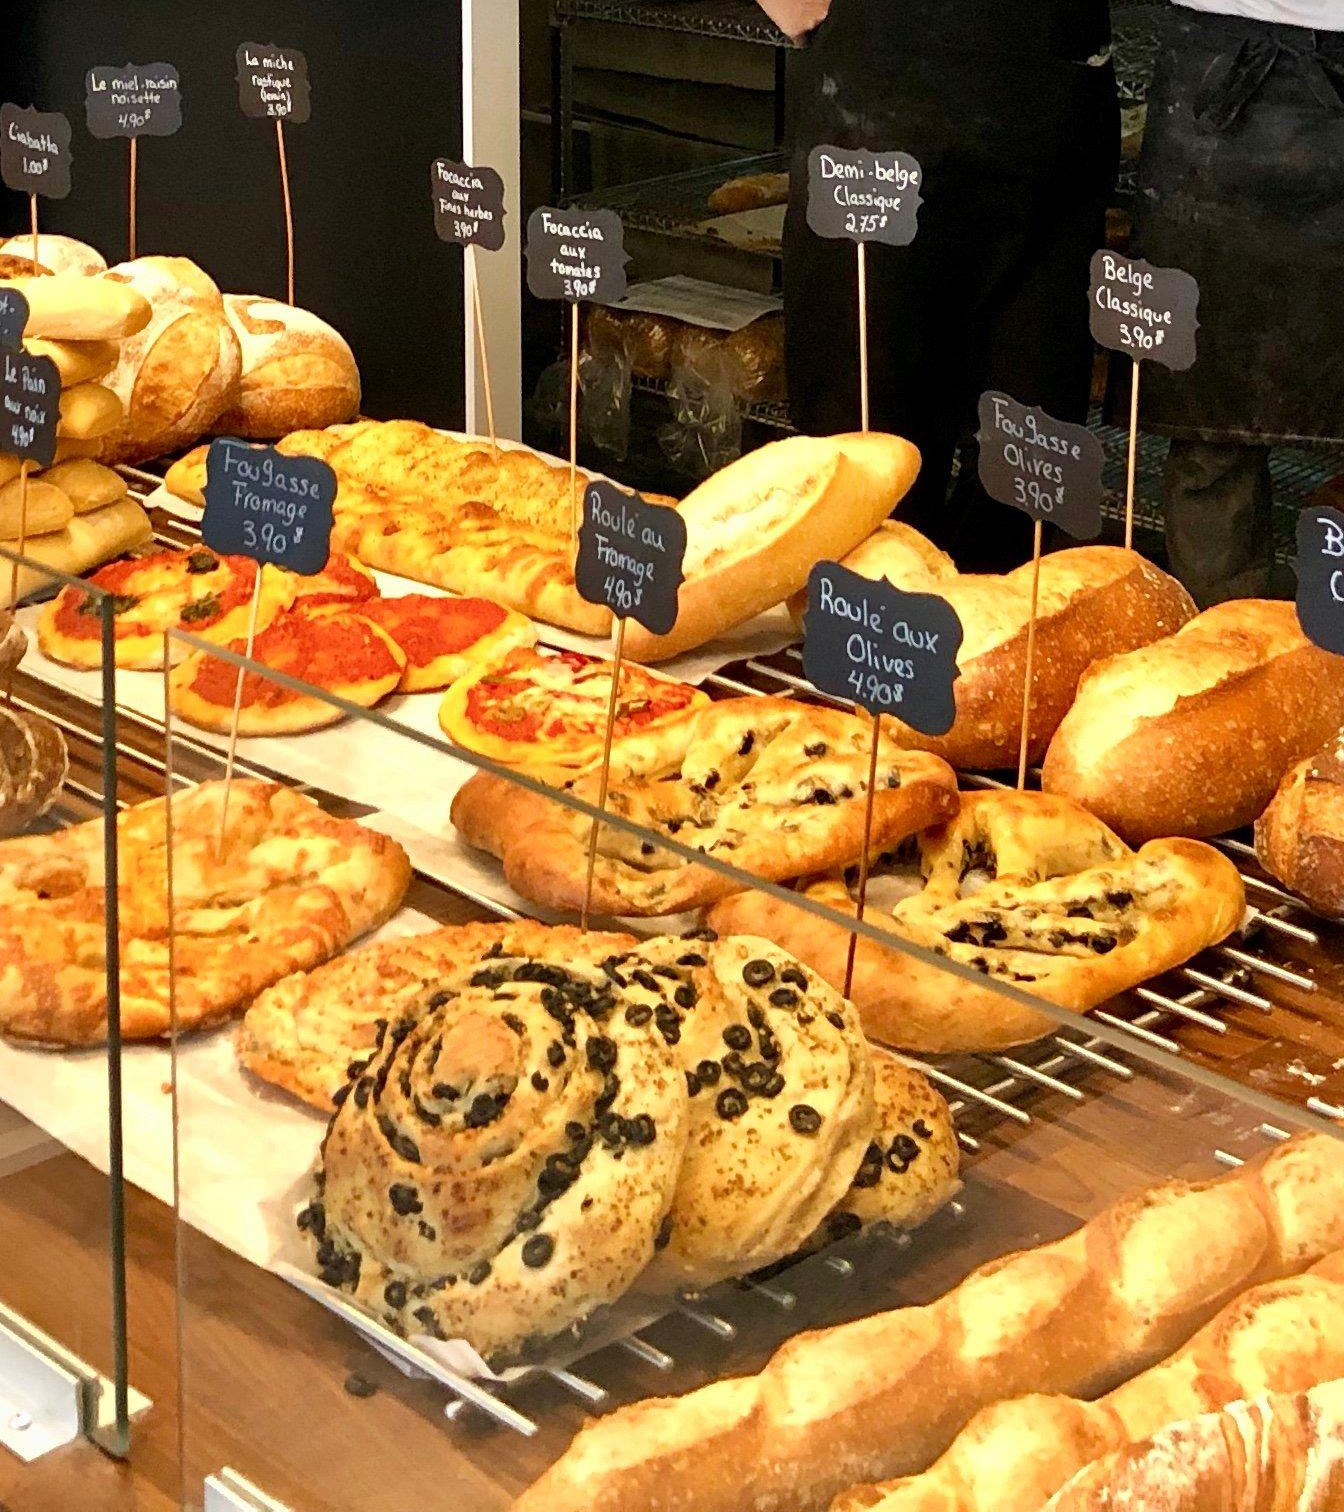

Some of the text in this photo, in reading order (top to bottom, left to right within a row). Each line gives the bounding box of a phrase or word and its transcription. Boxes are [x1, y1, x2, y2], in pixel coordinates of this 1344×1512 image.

[244, 49, 295, 71] La miche
[91, 72, 108, 92] Le
[111, 89, 162, 105] noisette
[118, 108, 153, 129] 4.90$
[436, 161, 485, 190] Focaccia
[451, 189, 470, 203] aux
[833, 184, 902, 214] Classique
[463, 203, 494, 221] herbes
[540, 212, 605, 242] Focaccia
[844, 212, 888, 233] 2.75$
[559, 244, 587, 260] aux
[549, 257, 602, 280] tomates
[1102, 255, 1154, 296] Belge
[1095, 285, 1173, 326] Classique
[1119, 323, 1165, 350] 3.90$
[991, 396, 1081, 461] Fougasse
[218, 438, 321, 501] Fougasse
[1003, 443, 1064, 485] Olives
[231, 480, 308, 527] Fromage
[589, 490, 667, 554] Roulé au
[594, 532, 655, 588] Fromage
[819, 577, 940, 655] Roulé aux
[846, 633, 915, 680] Olives
[847, 669, 905, 705] 4.90$
